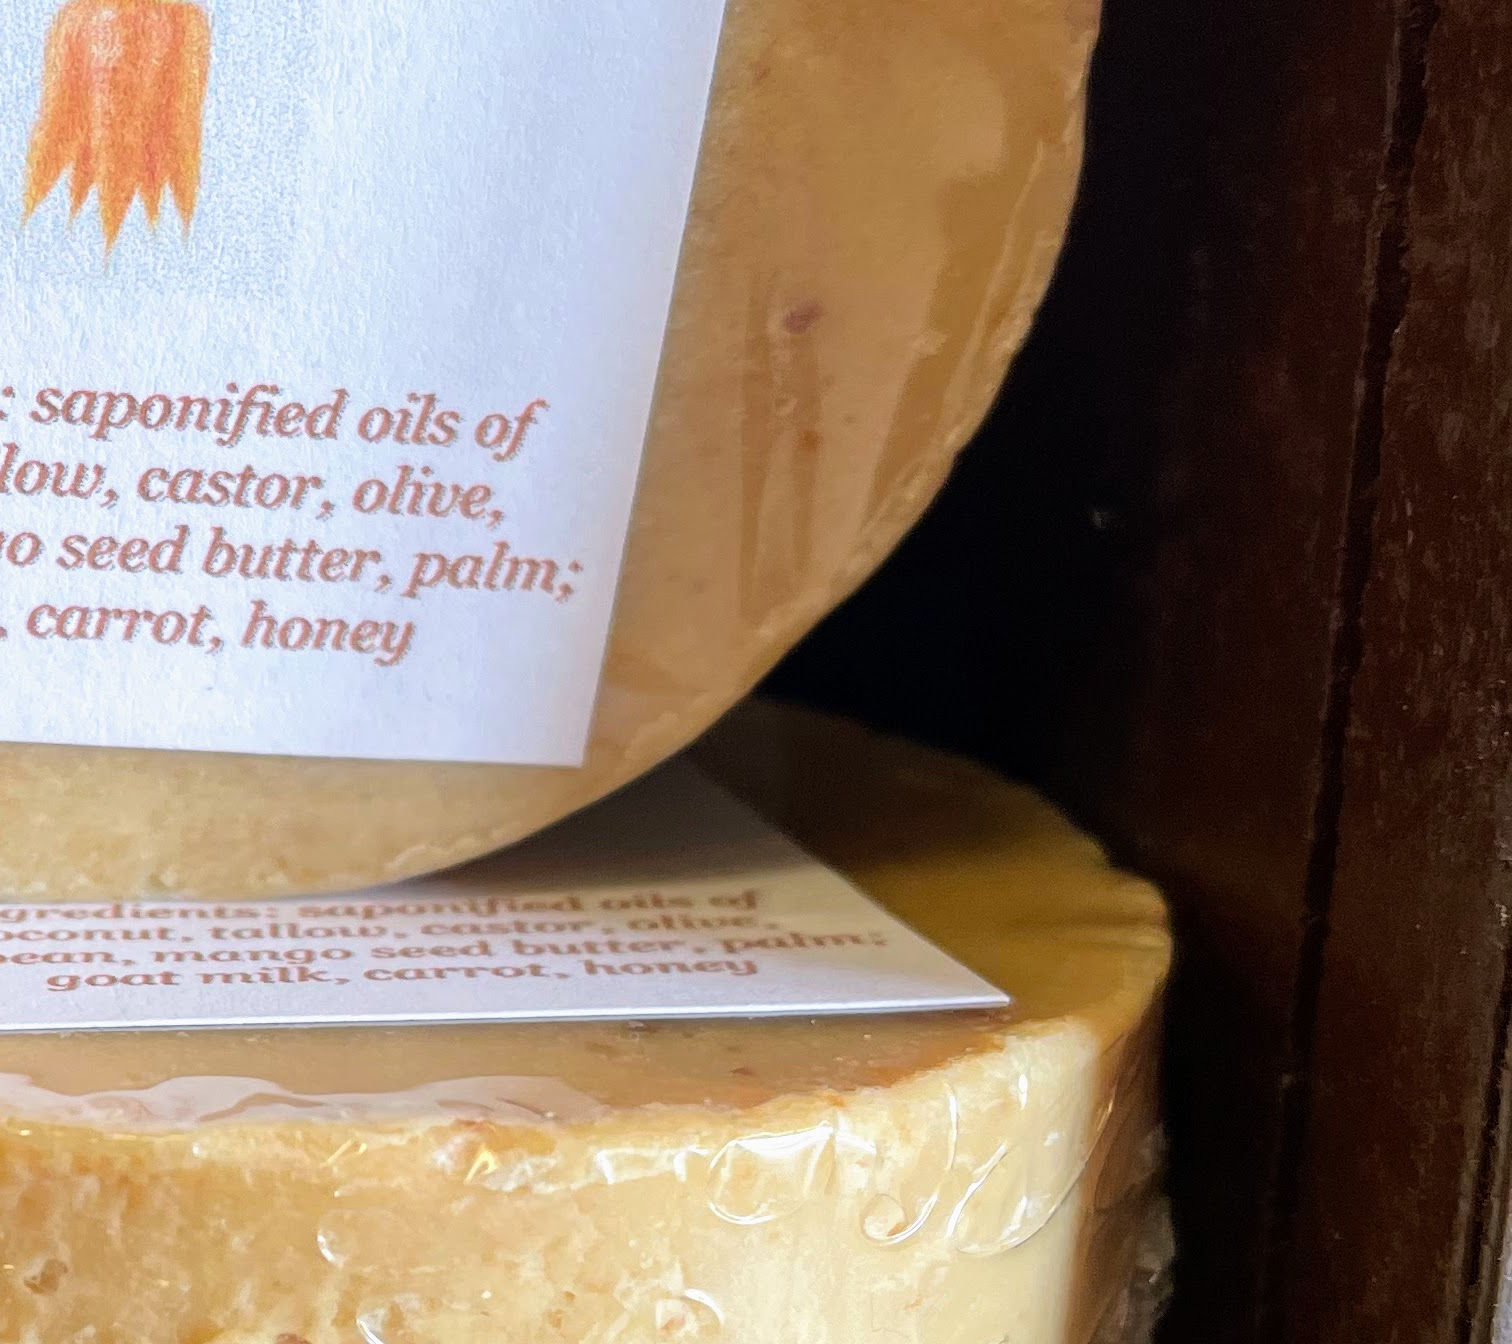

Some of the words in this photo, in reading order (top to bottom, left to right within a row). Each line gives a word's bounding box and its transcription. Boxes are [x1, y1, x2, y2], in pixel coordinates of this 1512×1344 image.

[31, 381, 347, 443] saponified
[357, 394, 458, 447] oils
[474, 398, 549, 459] of
[136, 466, 336, 518] castor,
[353, 466, 505, 524] olive,
[58, 526, 185, 576] seed
[202, 532, 389, 591] butter,
[403, 543, 583, 601] palm;
[27, 601, 221, 650] carrot,
[240, 602, 418, 666] honey
[152, 948, 352, 965] mango
[372, 940, 492, 959] seed
[512, 939, 706, 955] butter,
[209, 923, 407, 939] tallow,
[420, 920, 614, 935] castor,
[47, 971, 181, 991] goat
[197, 967, 350, 985] milk,
[364, 964, 568, 979] carrot,
[581, 960, 759, 976] honey
